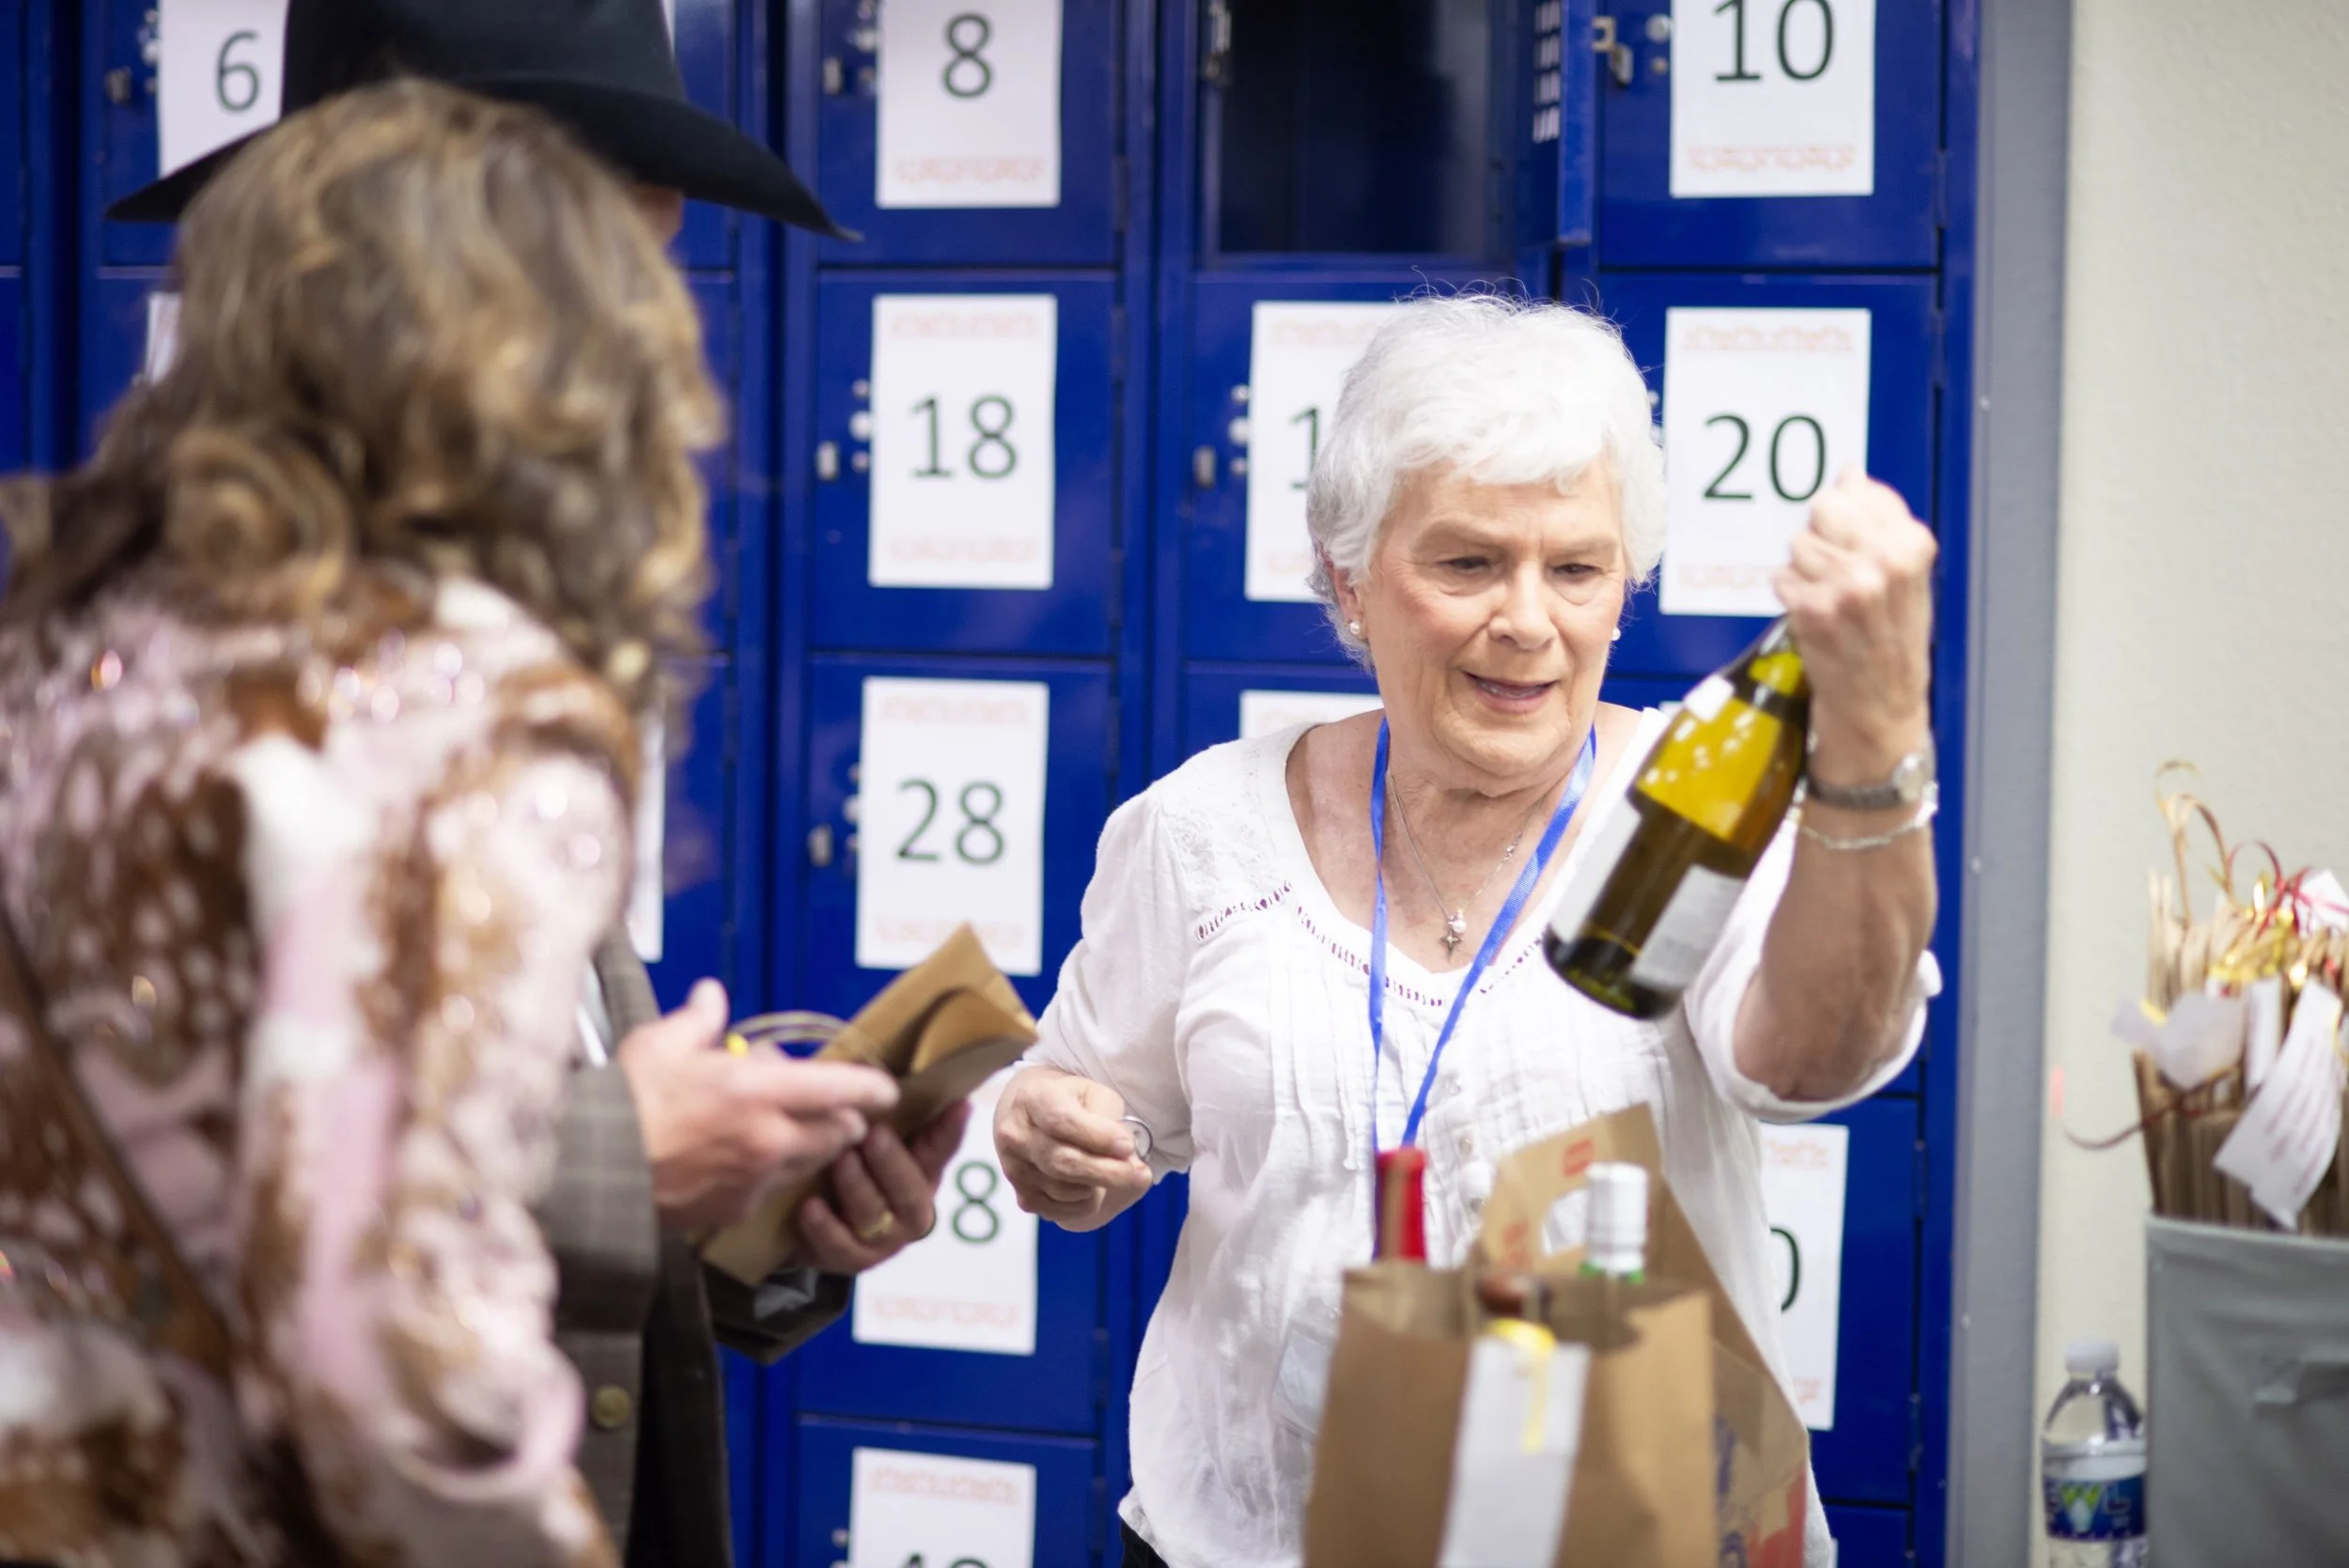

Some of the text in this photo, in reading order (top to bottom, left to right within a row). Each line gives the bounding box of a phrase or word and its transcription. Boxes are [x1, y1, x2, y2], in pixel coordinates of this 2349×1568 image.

[216, 29, 260, 113] 6
[942, 13, 993, 100] 8
[1714, 0, 1835, 83] 10
[912, 395, 1018, 480] 18
[1291, 406, 1322, 490] 1
[1702, 413, 1827, 503] 20
[894, 778, 1005, 866] 28
[951, 1161, 1000, 1245] 8
